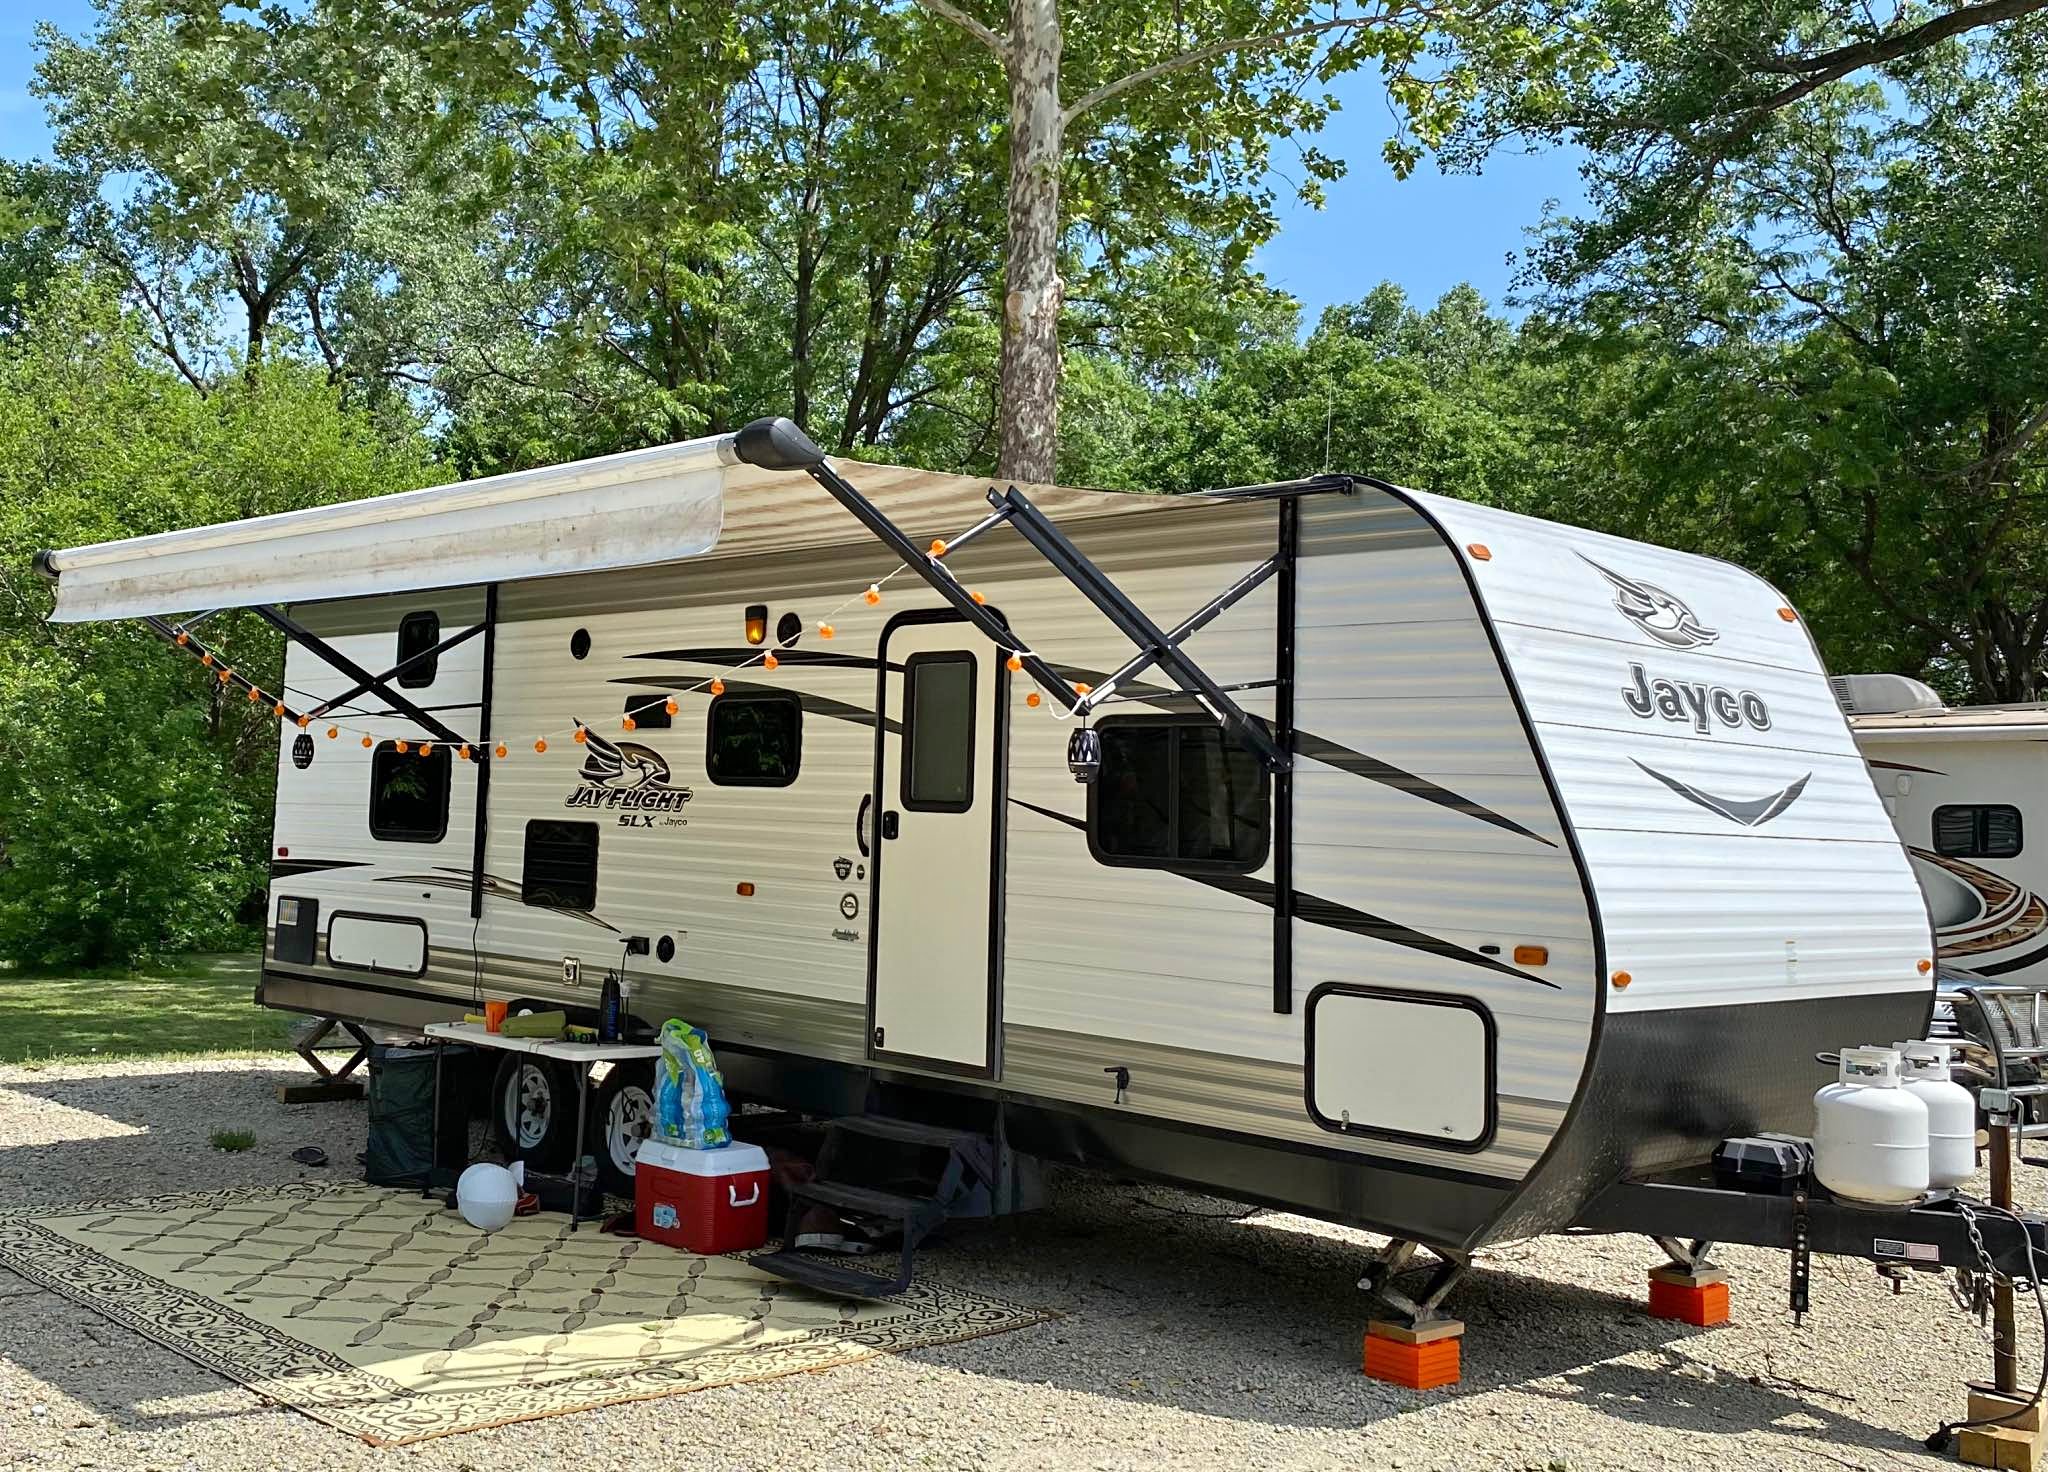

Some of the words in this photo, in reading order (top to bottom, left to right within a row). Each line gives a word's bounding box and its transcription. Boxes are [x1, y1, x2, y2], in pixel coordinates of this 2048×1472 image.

[1622, 662, 1771, 734] Jayco
[617, 814, 657, 828] SLX
[664, 817, 688, 828] Jayco
